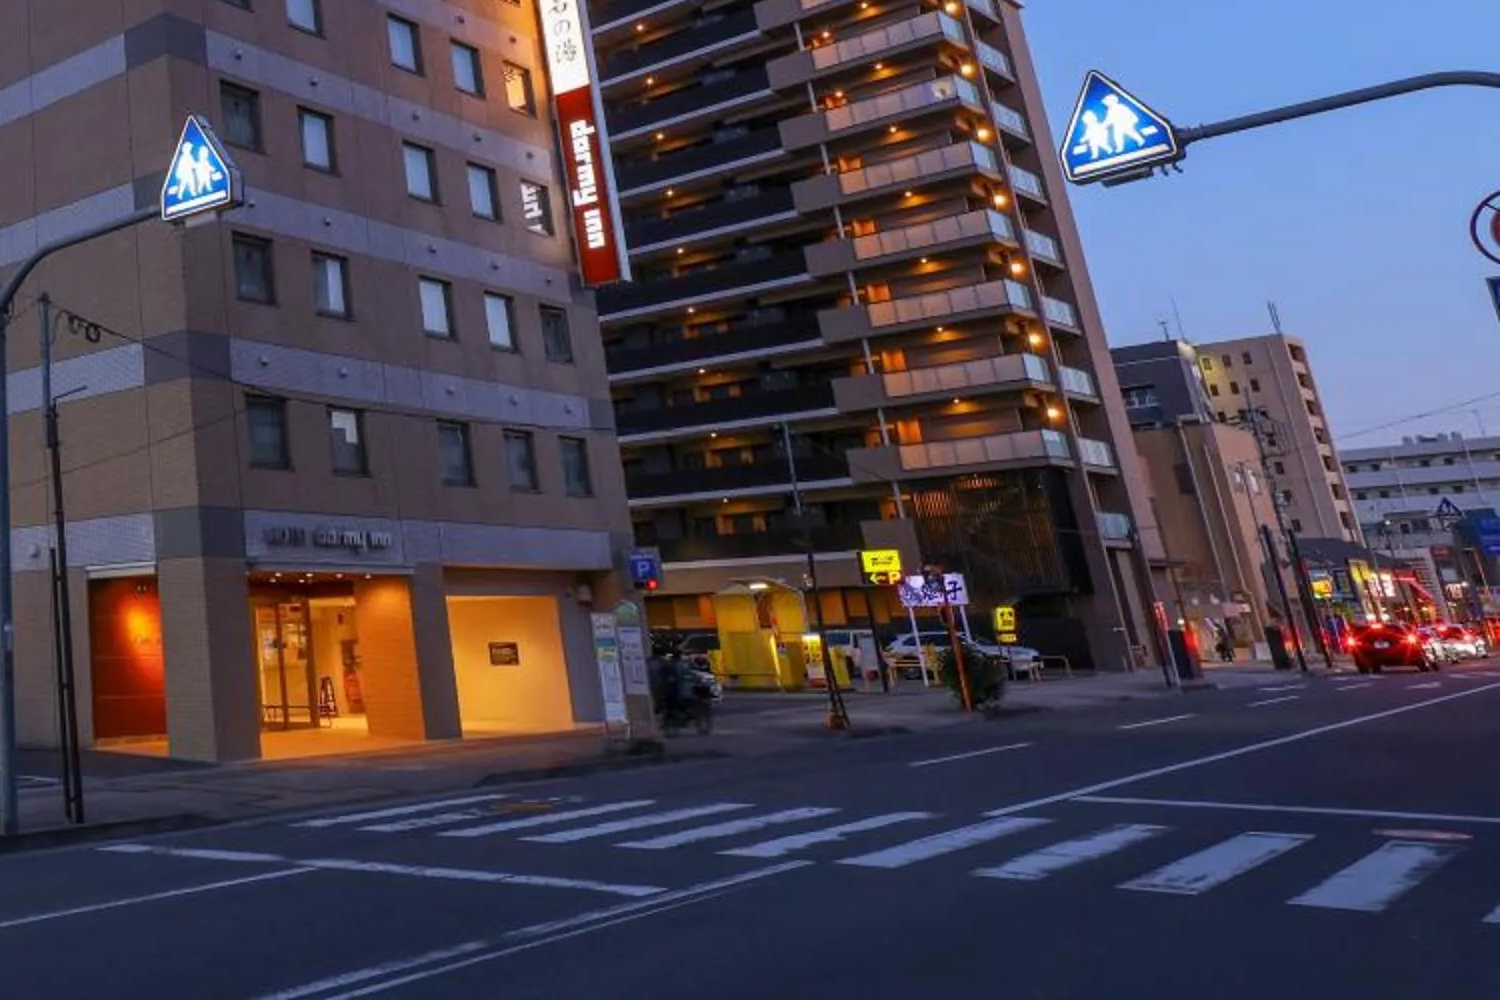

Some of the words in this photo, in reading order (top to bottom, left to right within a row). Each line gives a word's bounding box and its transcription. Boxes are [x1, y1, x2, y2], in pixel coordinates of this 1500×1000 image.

[569, 119, 599, 207] dormy
[583, 209, 606, 249] inn
[636, 560, 650, 578] P
[889, 571, 901, 585] P
